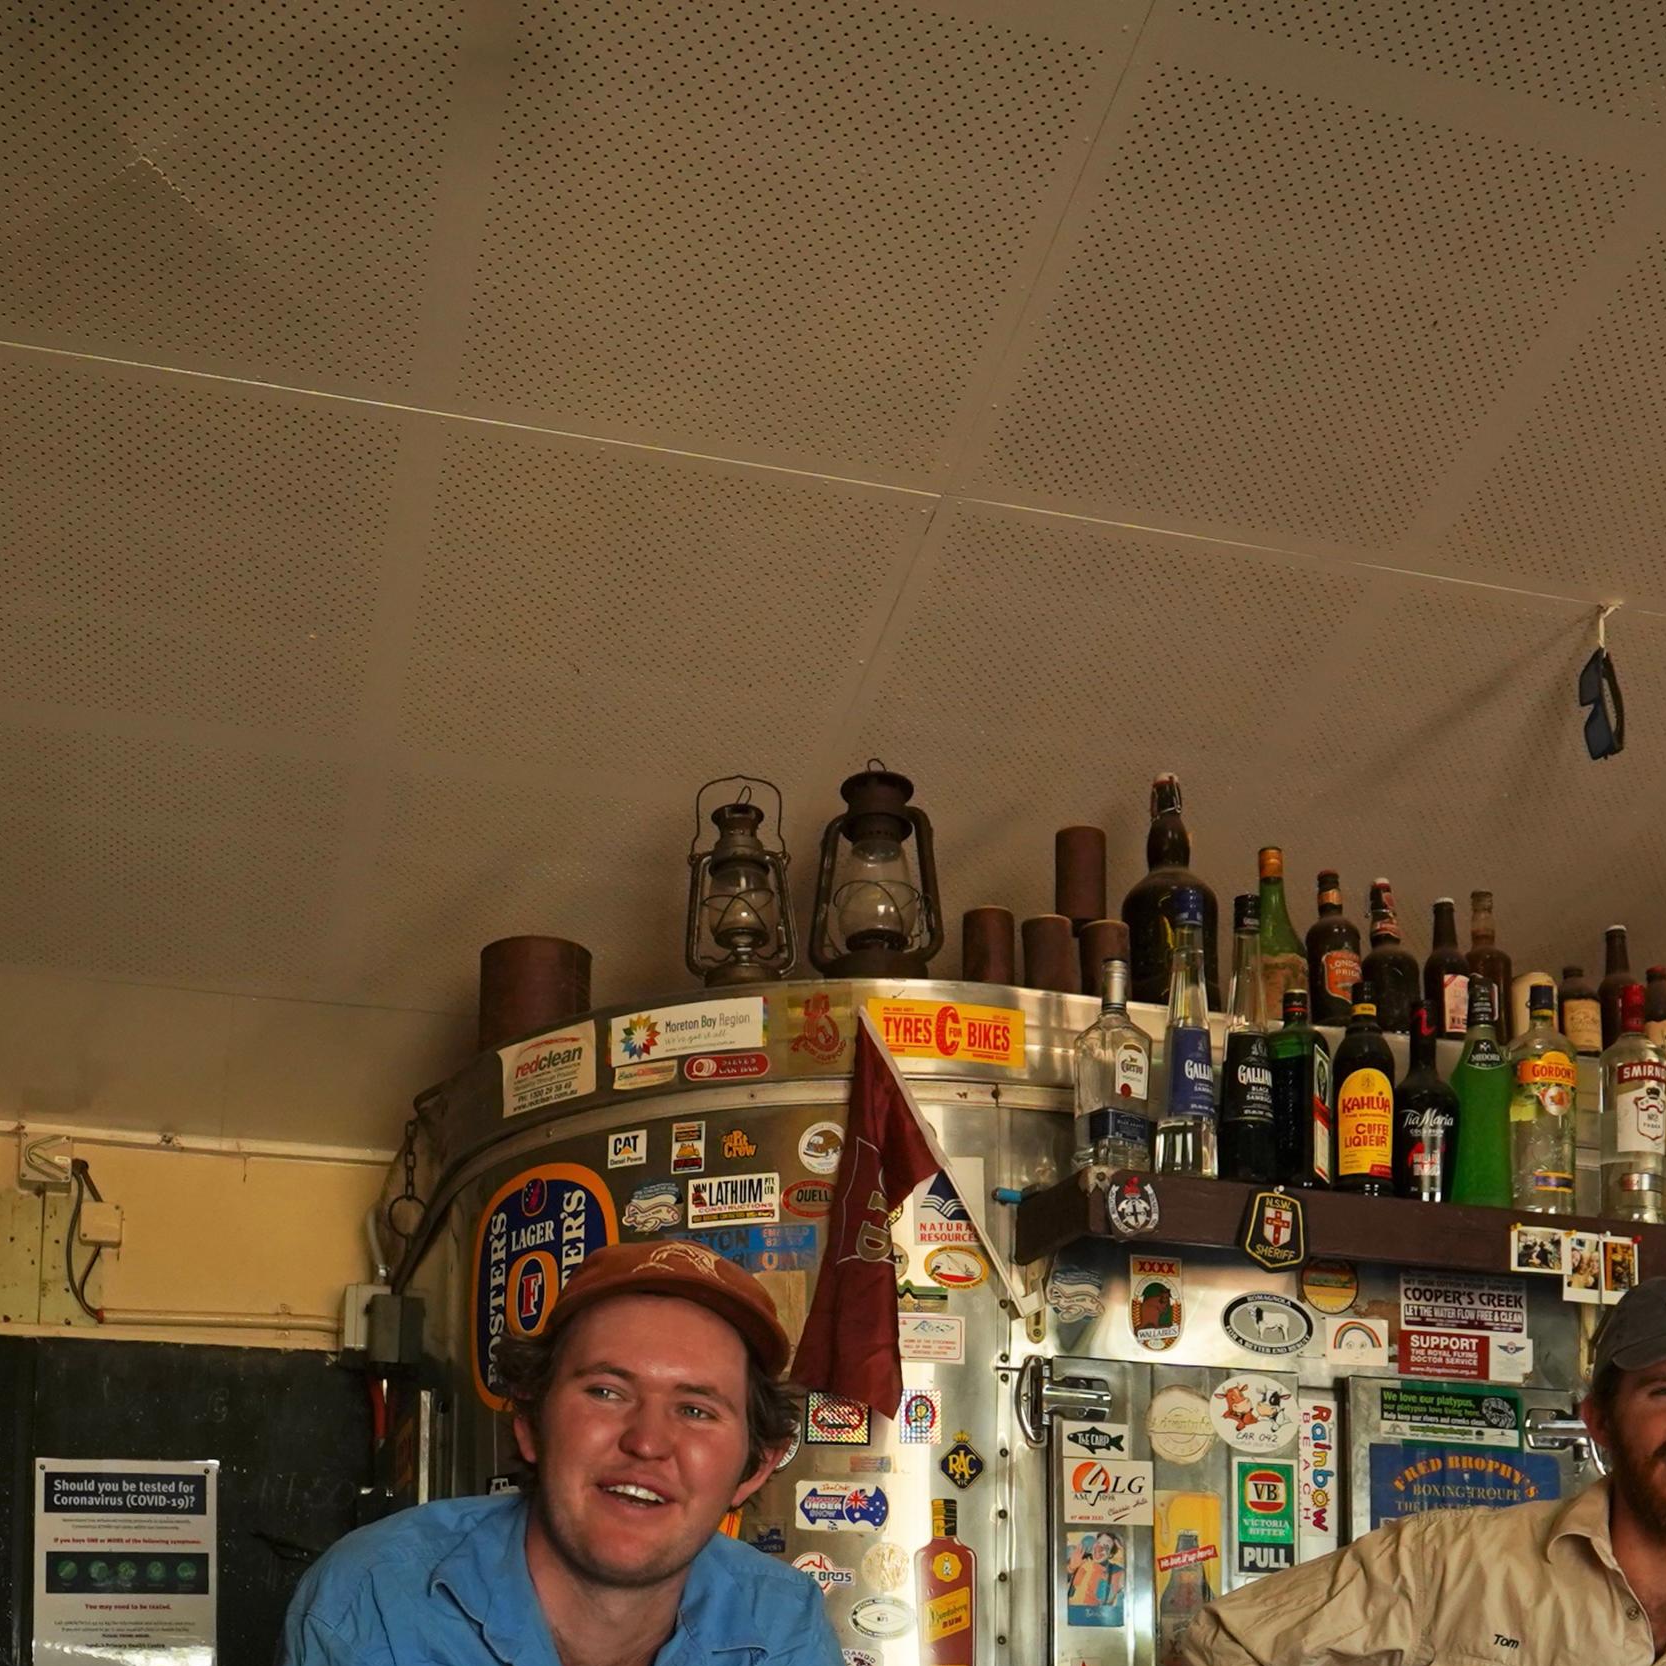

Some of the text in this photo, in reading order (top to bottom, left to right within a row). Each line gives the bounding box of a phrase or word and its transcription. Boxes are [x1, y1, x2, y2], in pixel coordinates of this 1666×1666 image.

[665, 1011, 751, 1034] Moreton Bay Region
[884, 1016, 1011, 1052] TYRES FOR BIKES
[514, 1046, 583, 1080] redclean
[1471, 1053, 1501, 1062] MIDORI
[1341, 1091, 1391, 1115] KAHLÚA
[1400, 1107, 1454, 1128] Tia Maria
[1355, 1123, 1389, 1135] COFFEE
[613, 1134, 639, 1156] CAT
[1344, 1134, 1388, 1149] LIQUEUR
[692, 1183, 707, 1194] VAN
[709, 1178, 763, 1207] LATHUM
[697, 1202, 774, 1214] CONSTRUCTIONS
[1265, 1197, 1292, 1210] N.S.W.
[919, 1221, 972, 1233] NATURA
[511, 1219, 556, 1252] LAGER
[1254, 1244, 1296, 1261] SHERIFF
[1137, 1260, 1177, 1275] XXXX
[521, 1271, 543, 1319] F
[1246, 1293, 1292, 1307] ROMAGNOLA
[1403, 1286, 1524, 1309] COOPER'S CREEK
[1405, 1304, 1523, 1322] LET THE WATER FLOW FREE CLEAN
[1137, 1328, 1179, 1340] WALLABIES
[1410, 1334, 1479, 1351] SUPPORT
[1410, 1348, 1478, 1359] THE ROYAL FLYING
[1410, 1355, 1478, 1366] DOCTOR SERVICE
[1383, 1390, 1476, 1409] We love our platypus,
[1396, 1404, 1427, 1415] platypus
[1428, 1406, 1443, 1414] love
[1383, 1411, 1396, 1420] Help
[1397, 1412, 1411, 1422] keep
[1423, 1414, 1439, 1423] rivers
[1440, 1415, 1450, 1424] and
[1450, 1416, 1470, 1425] creeks
[1090, 1433, 1111, 1447] CARP
[1235, 1431, 1279, 1443] CAR 042
[1301, 1411, 1312, 1521] BEACH
[1310, 1404, 1335, 1533] Rainbow
[1392, 1455, 1540, 1499] FRED BROPHY'S
[53, 1478, 195, 1494] Should you be tested for
[1252, 1482, 1278, 1501] VB
[1412, 1483, 1521, 1501] BOXING TROUPE
[53, 1493, 196, 1510] Coronavirus (COVID-19)?
[803, 1502, 843, 1511] UNDER
[1395, 1501, 1421, 1513] THE
[1242, 1517, 1290, 1529] VICTORIA
[1248, 1526, 1286, 1536] BITTER
[1243, 1546, 1290, 1569] PULL
[818, 1571, 852, 1583] BROS
[941, 1615, 963, 1630] RUM
[1493, 1633, 1520, 1650] Tom
